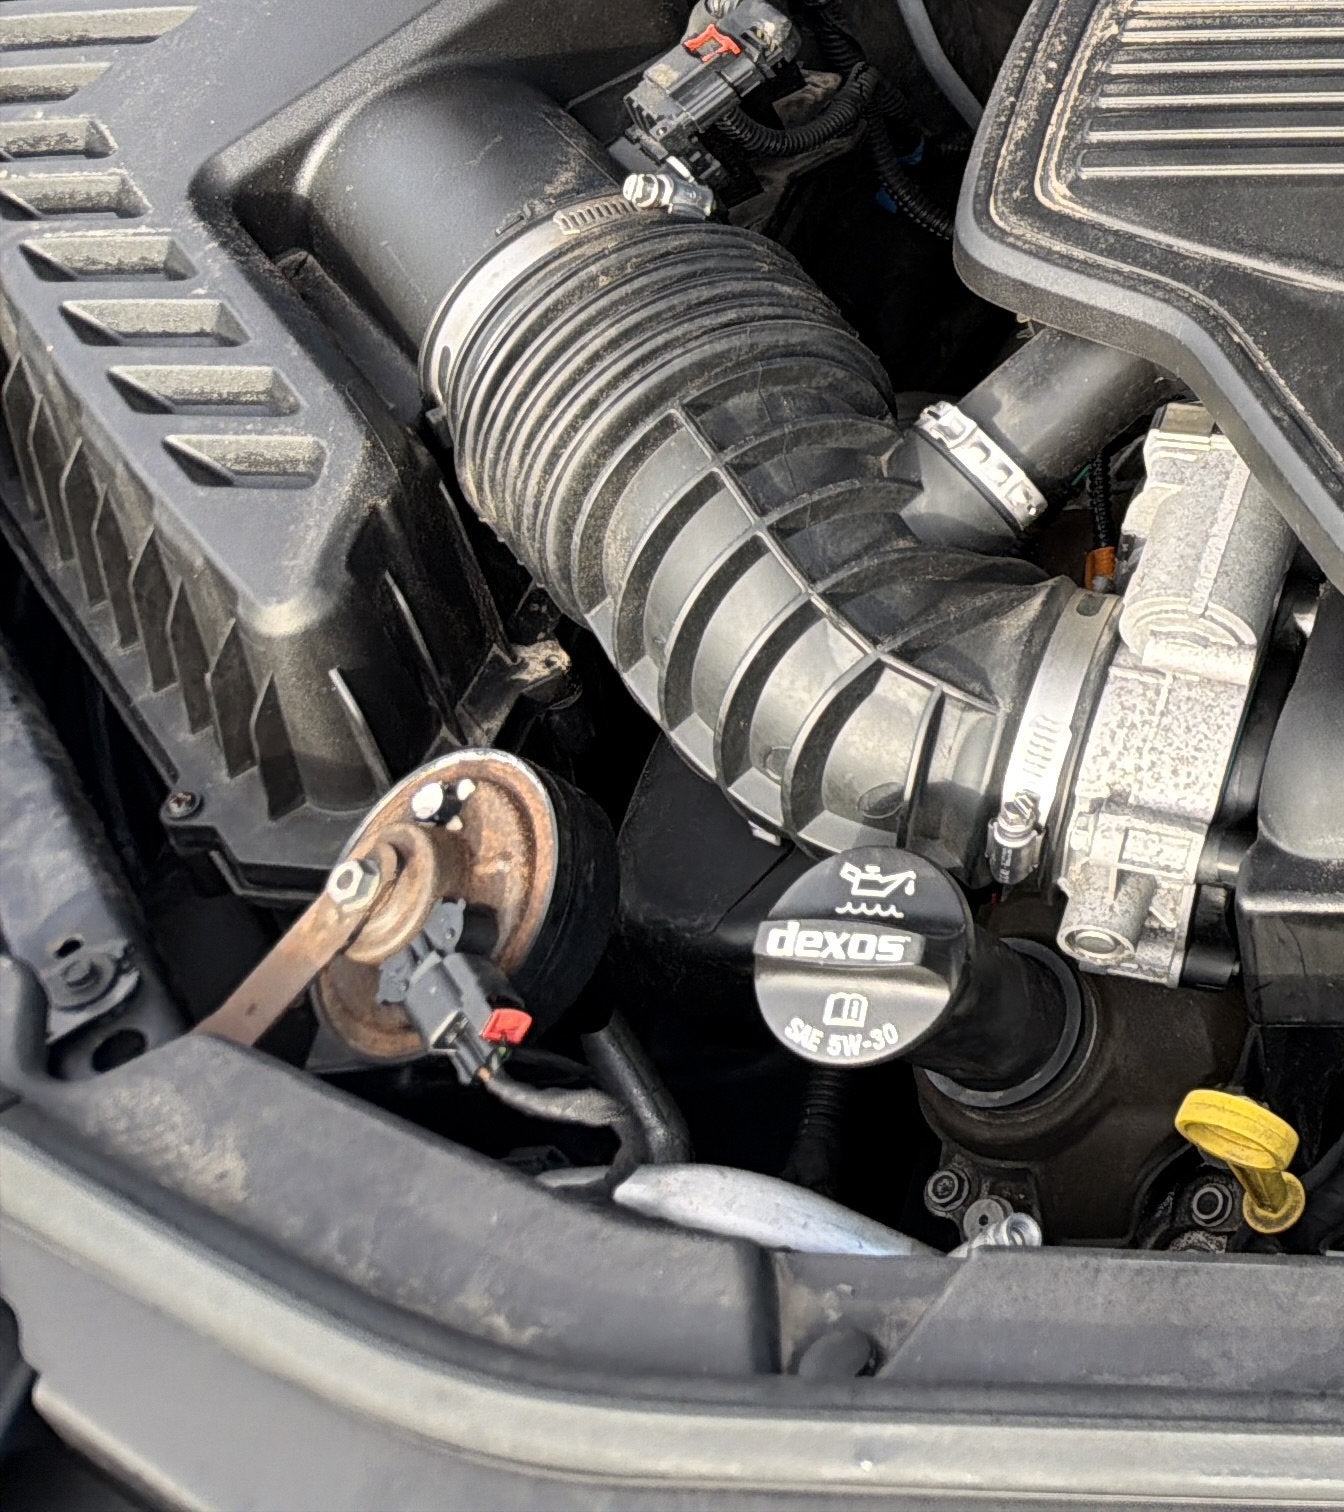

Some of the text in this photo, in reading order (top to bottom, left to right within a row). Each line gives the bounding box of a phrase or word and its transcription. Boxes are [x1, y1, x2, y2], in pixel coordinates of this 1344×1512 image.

[765, 921, 905, 962] dexos
[784, 1017, 899, 1057] SAE 5W-30
